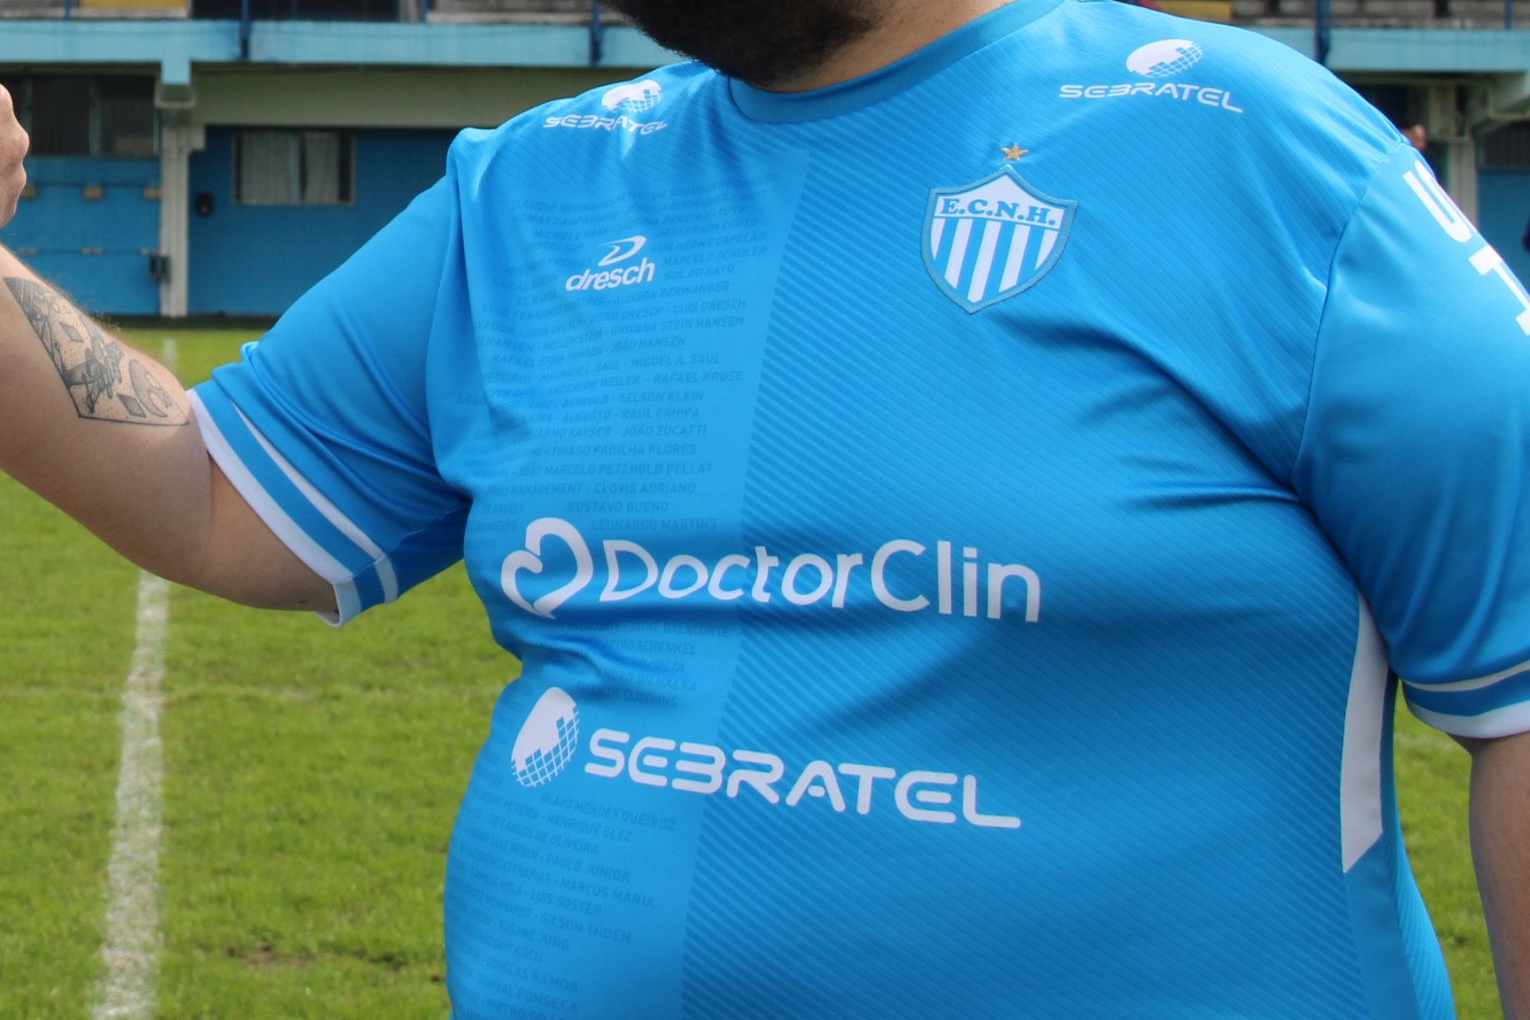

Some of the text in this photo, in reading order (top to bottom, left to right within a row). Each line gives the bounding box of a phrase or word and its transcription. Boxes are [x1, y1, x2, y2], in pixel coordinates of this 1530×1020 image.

[1059, 82, 1243, 113] SEBRATEL
[543, 114, 668, 136] SEBRATEL
[940, 197, 1056, 226] E.C.N.H.
[722, 217, 759, 230] COUTO
[650, 237, 713, 253] GUILHERME
[662, 252, 714, 267] MARCELO
[688, 266, 703, 279] DO
[705, 263, 735, 277] RAYO
[565, 257, 656, 292] dresch
[613, 289, 657, 304] ALISSON
[659, 280, 730, 298] BERWANGER
[588, 311, 620, 326] DIEGO
[621, 305, 665, 321] DRESCH
[673, 301, 699, 316] LUIS
[701, 298, 748, 313] DRESCH
[610, 322, 657, 336] GIOVANA
[660, 319, 693, 332] STEIN
[695, 315, 745, 329] HANSEN
[492, 353, 536, 368] RAFAEL
[567, 345, 603, 361] HANSEN
[637, 335, 687, 349] HANSEN
[594, 359, 620, 373] SAUL
[630, 355, 672, 368] MIGUEL
[689, 353, 722, 365] SAUL
[547, 379, 598, 396] ANDERSON
[599, 374, 641, 388] WEILER
[652, 371, 700, 384] RAFAEL
[702, 369, 744, 382] KRUSE
[618, 391, 666, 404] GELSON
[667, 389, 705, 402] KLEIN
[562, 410, 611, 423] AUGUSTO
[621, 407, 652, 420] RAUL
[655, 407, 700, 420] CRIPPA
[568, 426, 612, 439] KAYSER
[622, 421, 654, 437] JOÃO
[656, 424, 708, 436] ZUCATTI
[552, 445, 591, 458] THIAGO
[592, 443, 645, 456] PADILHA
[648, 443, 697, 455] FLORES
[544, 463, 596, 477] MARCELO
[598, 462, 663, 476] PETZHOLD
[665, 462, 714, 475] PELLAT
[511, 482, 587, 496] MANAGEMENT
[593, 481, 637, 495] CLOVIS
[638, 481, 697, 495] ADRIANO
[567, 500, 623, 514] GUSTAVO
[626, 500, 670, 513] BUENO
[591, 518, 718, 531] LEONARDO MARTINS
[635, 639, 696, 656] SCHENKEL
[623, 688, 679, 708] CLOTHING
[584, 728, 1021, 828] SEBRATEL
[504, 798, 540, 820] PEREIRA
[546, 813, 601, 837] HENRIQUE
[602, 825, 633, 843] ELTZ
[540, 791, 677, 831] OLAVO MENDES QUEIROZ
[500, 818, 534, 839] CARLOS
[534, 829, 549, 843] DE
[549, 833, 599, 856] OLIVEIRA
[509, 842, 539, 860] BEDIN
[546, 853, 583, 872] PAULO
[584, 864, 632, 884] JUNIOR
[530, 888, 554, 905] LUIS
[555, 894, 603, 917] SOSTER
[559, 876, 657, 909] MARCUS MARIA
[498, 919, 537, 942] ROSANE
[537, 933, 570, 951] JUNG
[539, 912, 583, 934] GILSON
[585, 923, 633, 945] THOEN
[512, 945, 544, 963] KOCH
[531, 969, 579, 992] RAMOS
[487, 997, 526, 1020] PIETRO
[516, 986, 580, 1015] FONSECA
